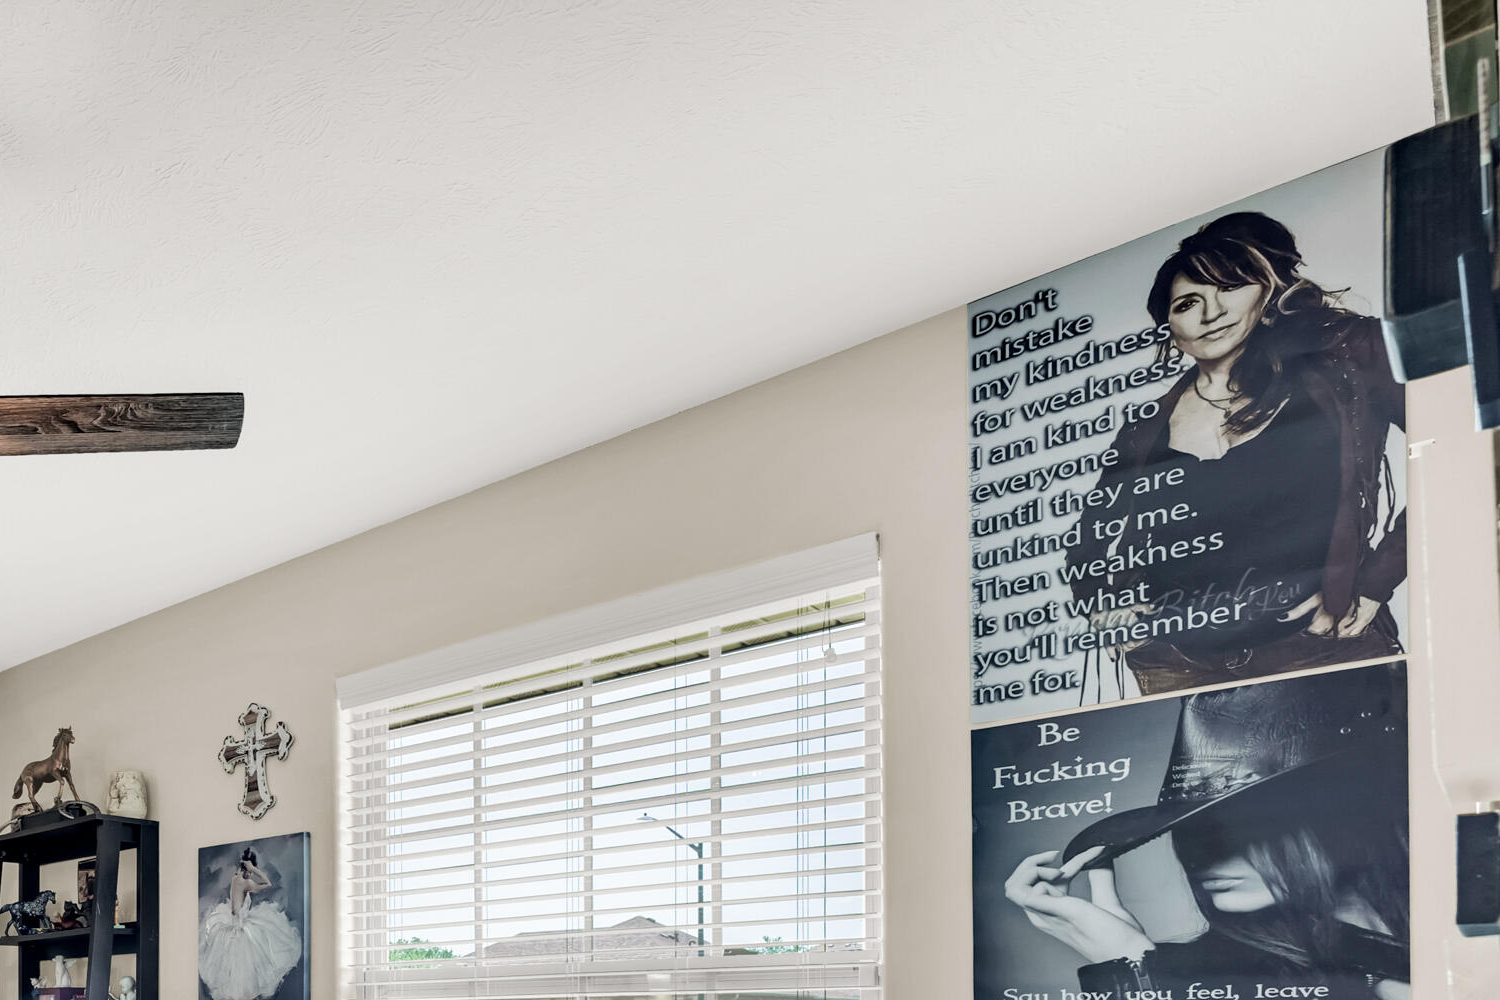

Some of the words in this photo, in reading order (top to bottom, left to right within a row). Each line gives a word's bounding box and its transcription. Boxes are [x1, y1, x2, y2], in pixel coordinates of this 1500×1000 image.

[973, 288, 1058, 337] Don't
[973, 314, 1093, 370] mistake
[973, 371, 1019, 403] my
[1027, 322, 1171, 386] kindness
[973, 406, 1015, 437] for
[1024, 357, 1190, 421] weakness.
[975, 446, 982, 469] I
[991, 437, 1037, 464] am
[1046, 408, 1115, 448] kind
[1126, 400, 1160, 424] to
[975, 447, 1119, 503] everyone
[975, 498, 1042, 537] until
[1052, 481, 1123, 514] they
[1133, 466, 1185, 496] are
[975, 521, 1081, 569] unkind
[1092, 514, 1126, 542] to
[1136, 500, 1198, 531] me.
[974, 569, 1050, 604] Then
[1060, 531, 1224, 582] weakness
[976, 612, 997, 637] is
[1006, 600, 1058, 629] not
[1067, 580, 1150, 617] what
[975, 633, 1056, 676] you'll
[1067, 600, 1246, 655] remember
[977, 672, 1024, 705] me
[1032, 668, 1080, 696] for.
[1037, 722, 1080, 747] Be
[993, 755, 1131, 790] Fucking
[1007, 793, 1113, 824] Brave!
[1255, 983, 1329, 999] leave
